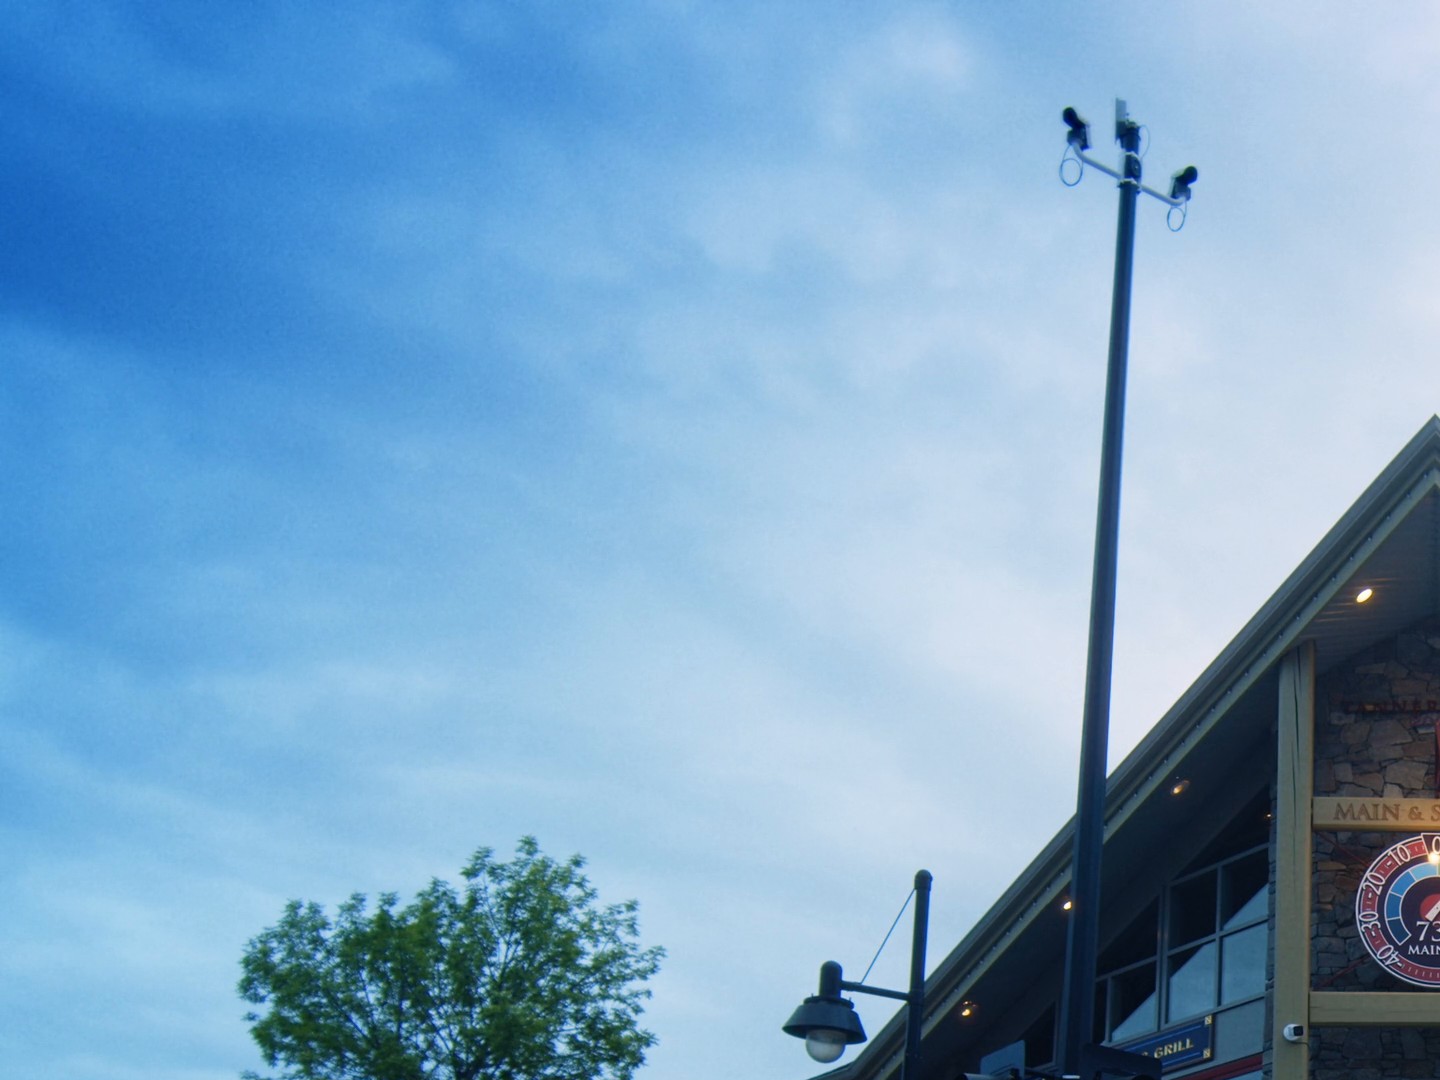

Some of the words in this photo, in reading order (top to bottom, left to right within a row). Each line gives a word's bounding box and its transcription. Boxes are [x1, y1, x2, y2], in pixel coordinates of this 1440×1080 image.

[1333, 802, 1400, 821] MAIN
[1408, 805, 1425, 822] &
[1153, 1038, 1193, 1058] GRILL
